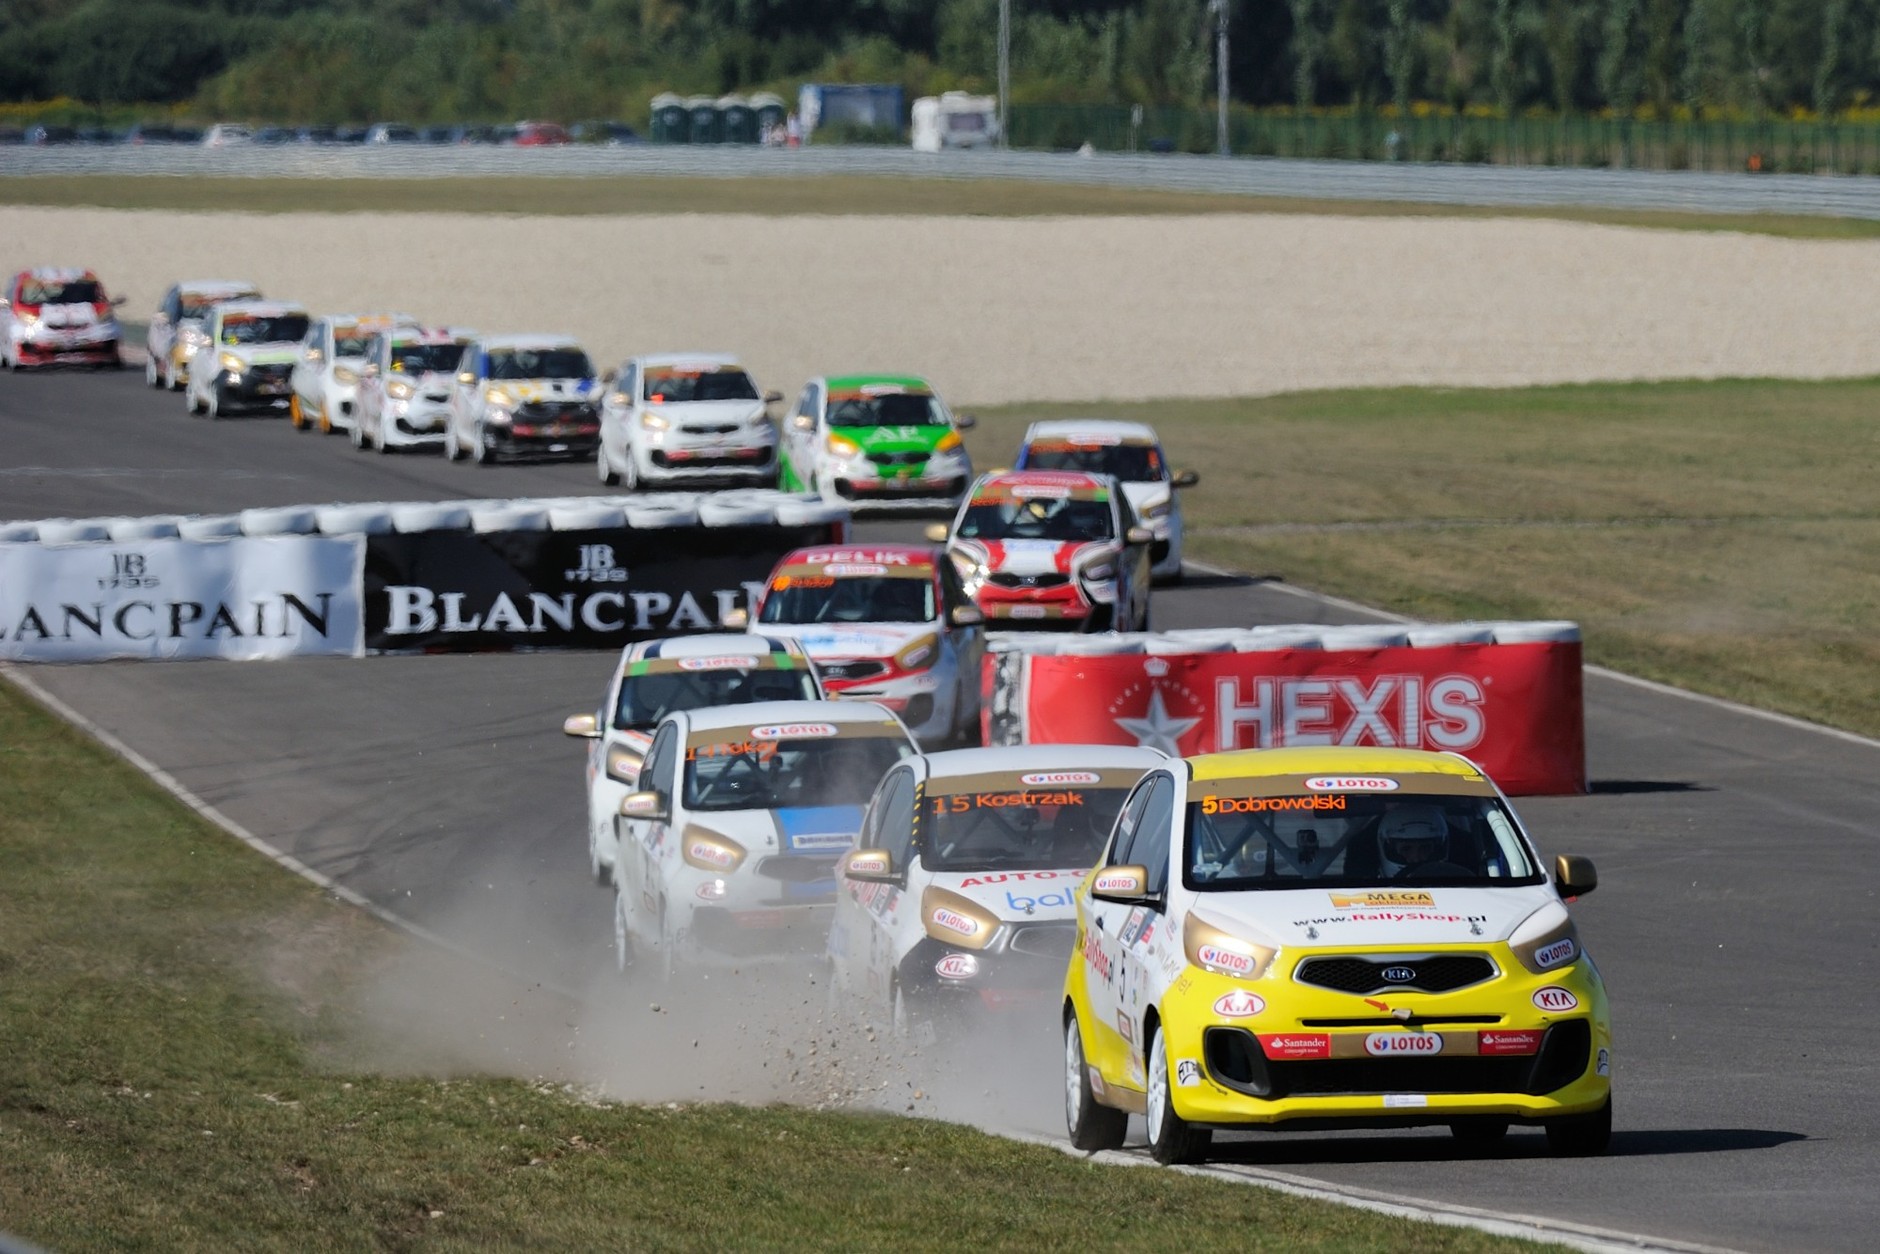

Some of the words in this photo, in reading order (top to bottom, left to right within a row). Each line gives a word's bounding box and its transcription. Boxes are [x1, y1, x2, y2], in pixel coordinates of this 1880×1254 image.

[0, 592, 334, 642] ANCPAIN
[1215, 674, 1486, 750] HEXIS
[780, 724, 829, 735] LOTOS
[1047, 773, 1091, 783] LOTOS
[1337, 778, 1388, 788] LOTOS
[932, 796, 970, 814] 15
[976, 791, 1084, 808] Kostrzak
[1202, 795, 1218, 814] 5
[1218, 795, 1346, 813] Dobrowolski
[859, 862, 881, 870] LOTOS
[1107, 879, 1132, 888] LOTOS
[1293, 912, 1487, 926] www.RallyShop.pl
[1549, 942, 1572, 960] LOTOS
[1215, 952, 1249, 970] LOTOS
[1388, 969, 1410, 979] KIA
[1222, 999, 1255, 1012] KA
[1540, 993, 1572, 1006] KIA
[1284, 1037, 1326, 1047] Santander
[1391, 1036, 1433, 1050] LOTOS
